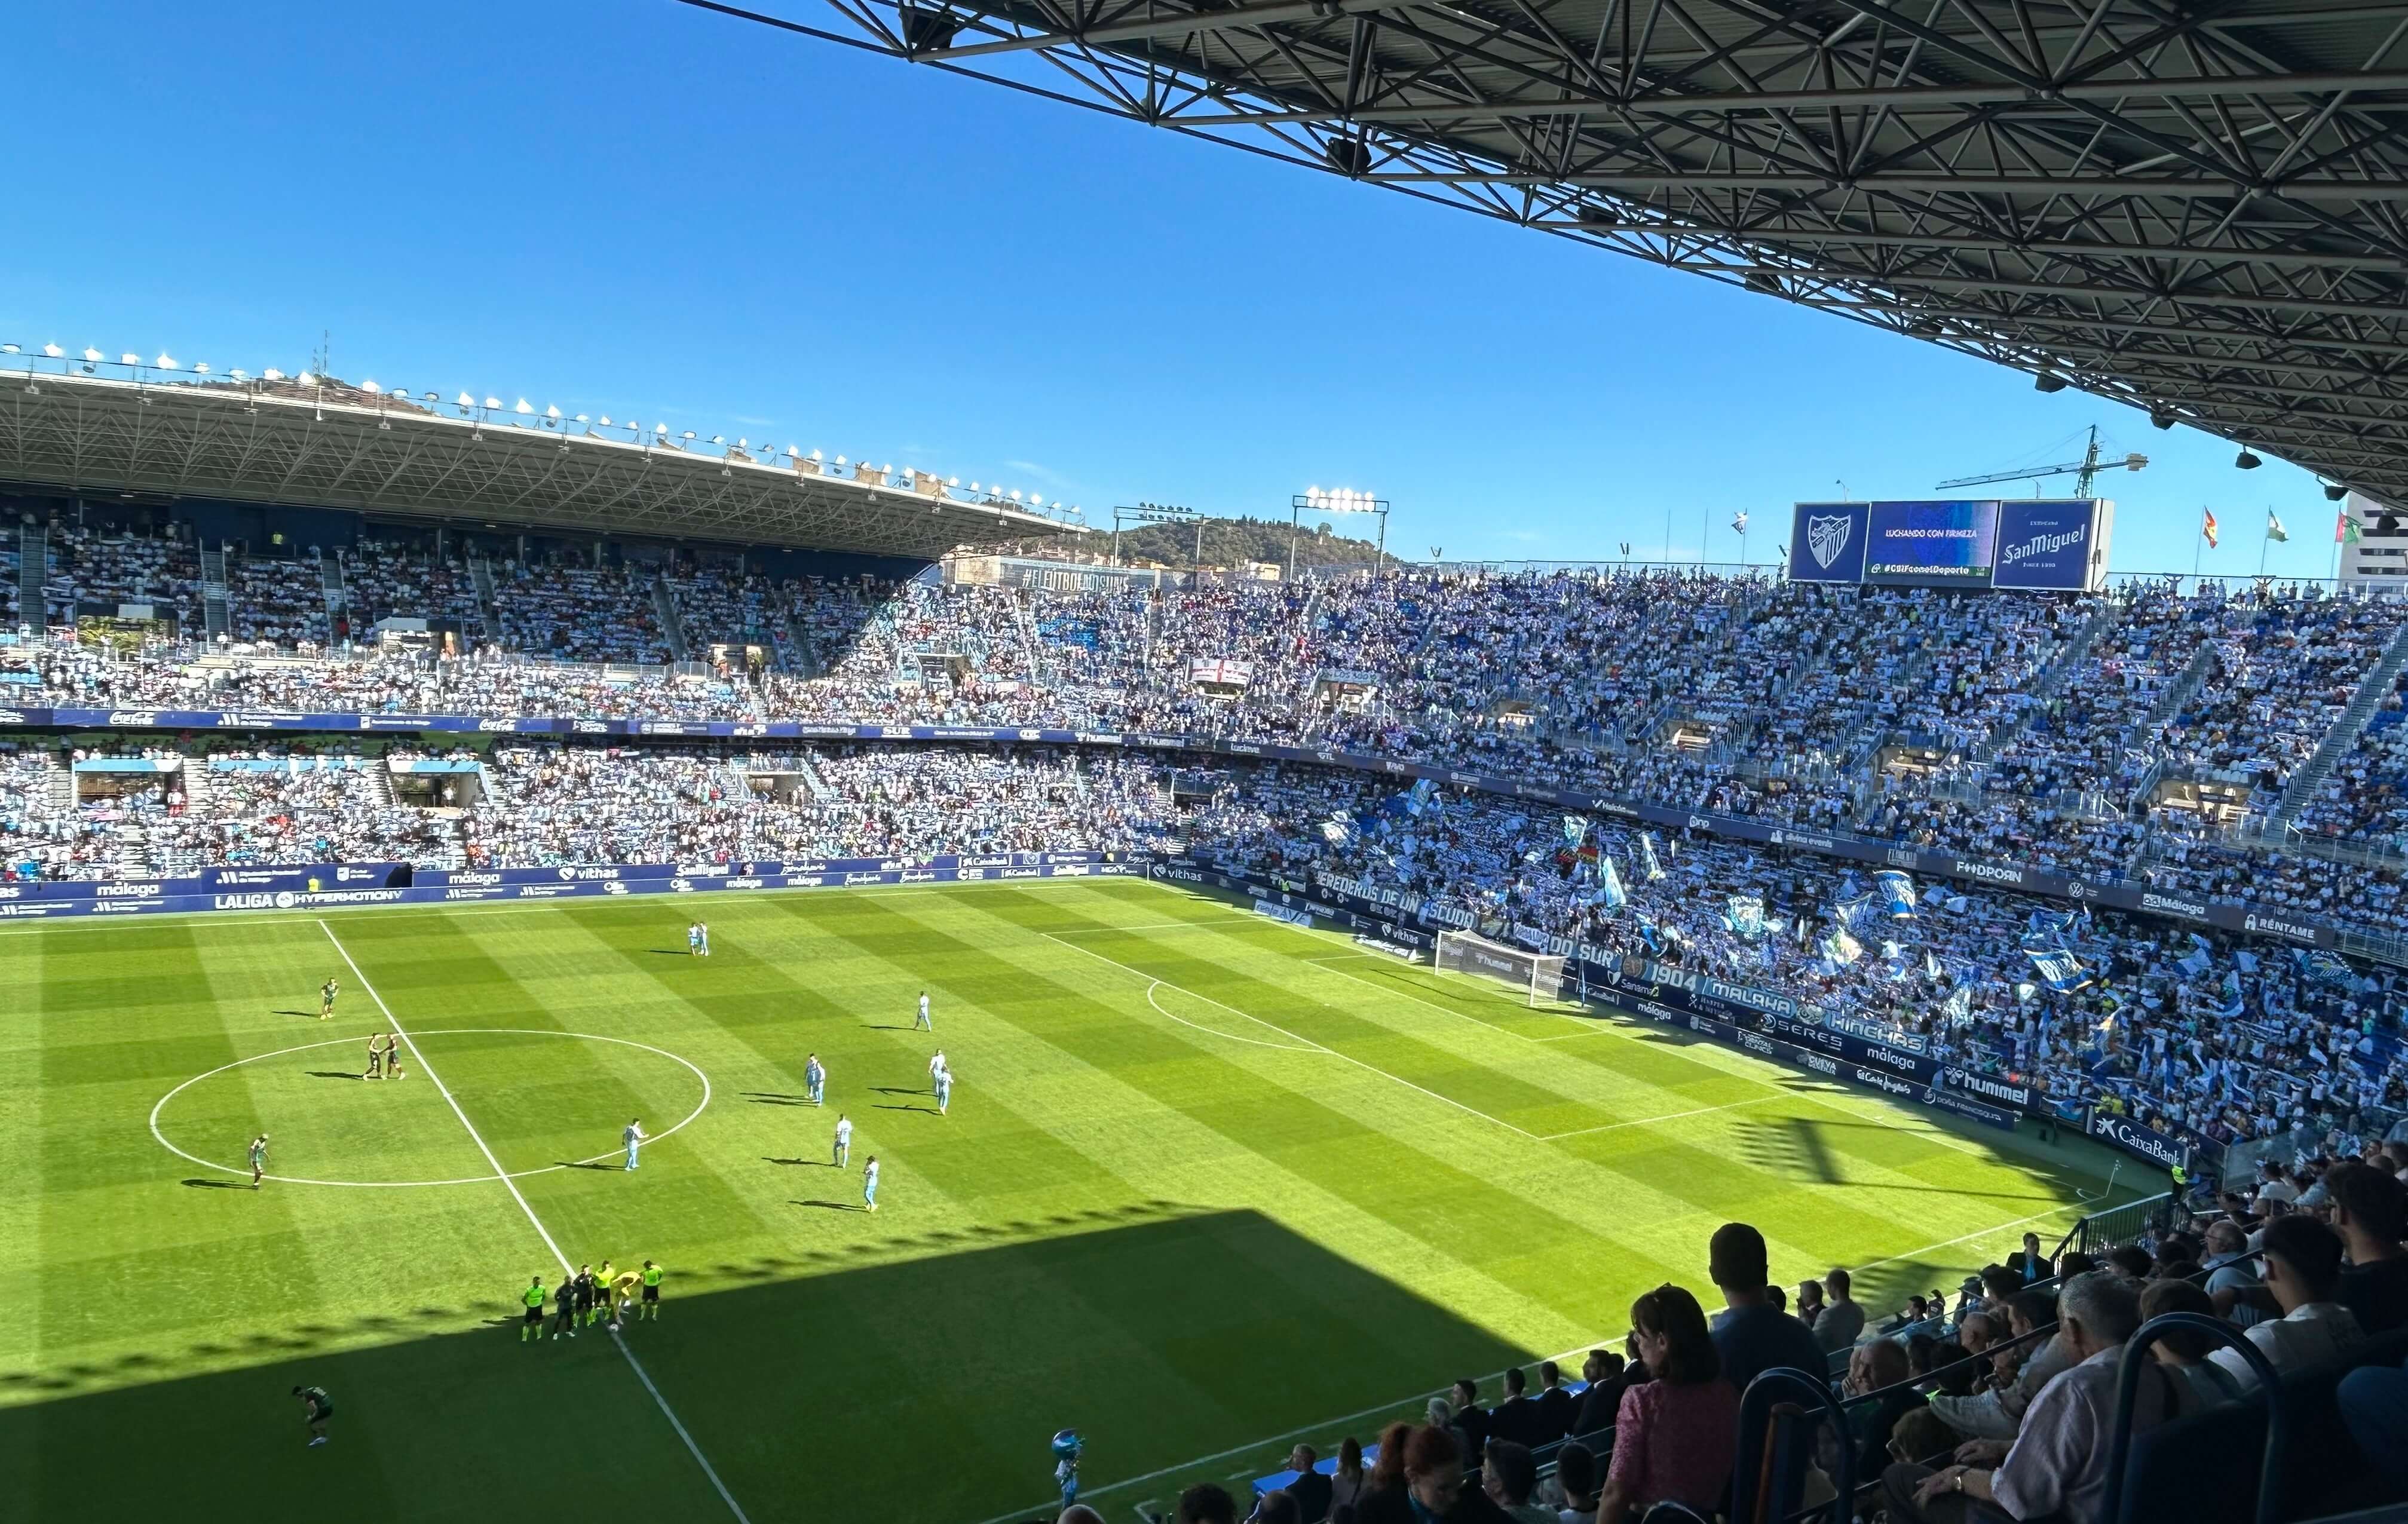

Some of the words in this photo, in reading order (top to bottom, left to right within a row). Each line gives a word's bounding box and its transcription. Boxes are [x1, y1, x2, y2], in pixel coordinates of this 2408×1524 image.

[1927, 529, 1944, 538] CON
[883, 726, 911, 735] SUR
[1086, 732, 1122, 743] hummel
[1149, 736, 1184, 747] hummel
[449, 871, 500, 885] málaga
[578, 867, 618, 879] vithas
[1168, 869, 1202, 881] vithas
[97, 882, 159, 897] málaga
[215, 894, 273, 909] LALIGA
[1381, 888, 1398, 906] DE
[1399, 891, 1421, 913] UN
[2161, 897, 2204, 915] Málaga
[1389, 928, 1419, 945] vithas
[1579, 944, 1614, 968] SUR
[1651, 964, 1698, 991] 1904
[1638, 1002, 1671, 1020] málaga
[1712, 981, 1791, 1014] MALAKA
[1830, 1012, 1923, 1051] HINCHAS
[1778, 1020, 1842, 1047] SERES
[1867, 1046, 1916, 1070] málaga
[1965, 1072, 2029, 1105] hummel
[2119, 1125, 2180, 1166] CaixaBank
